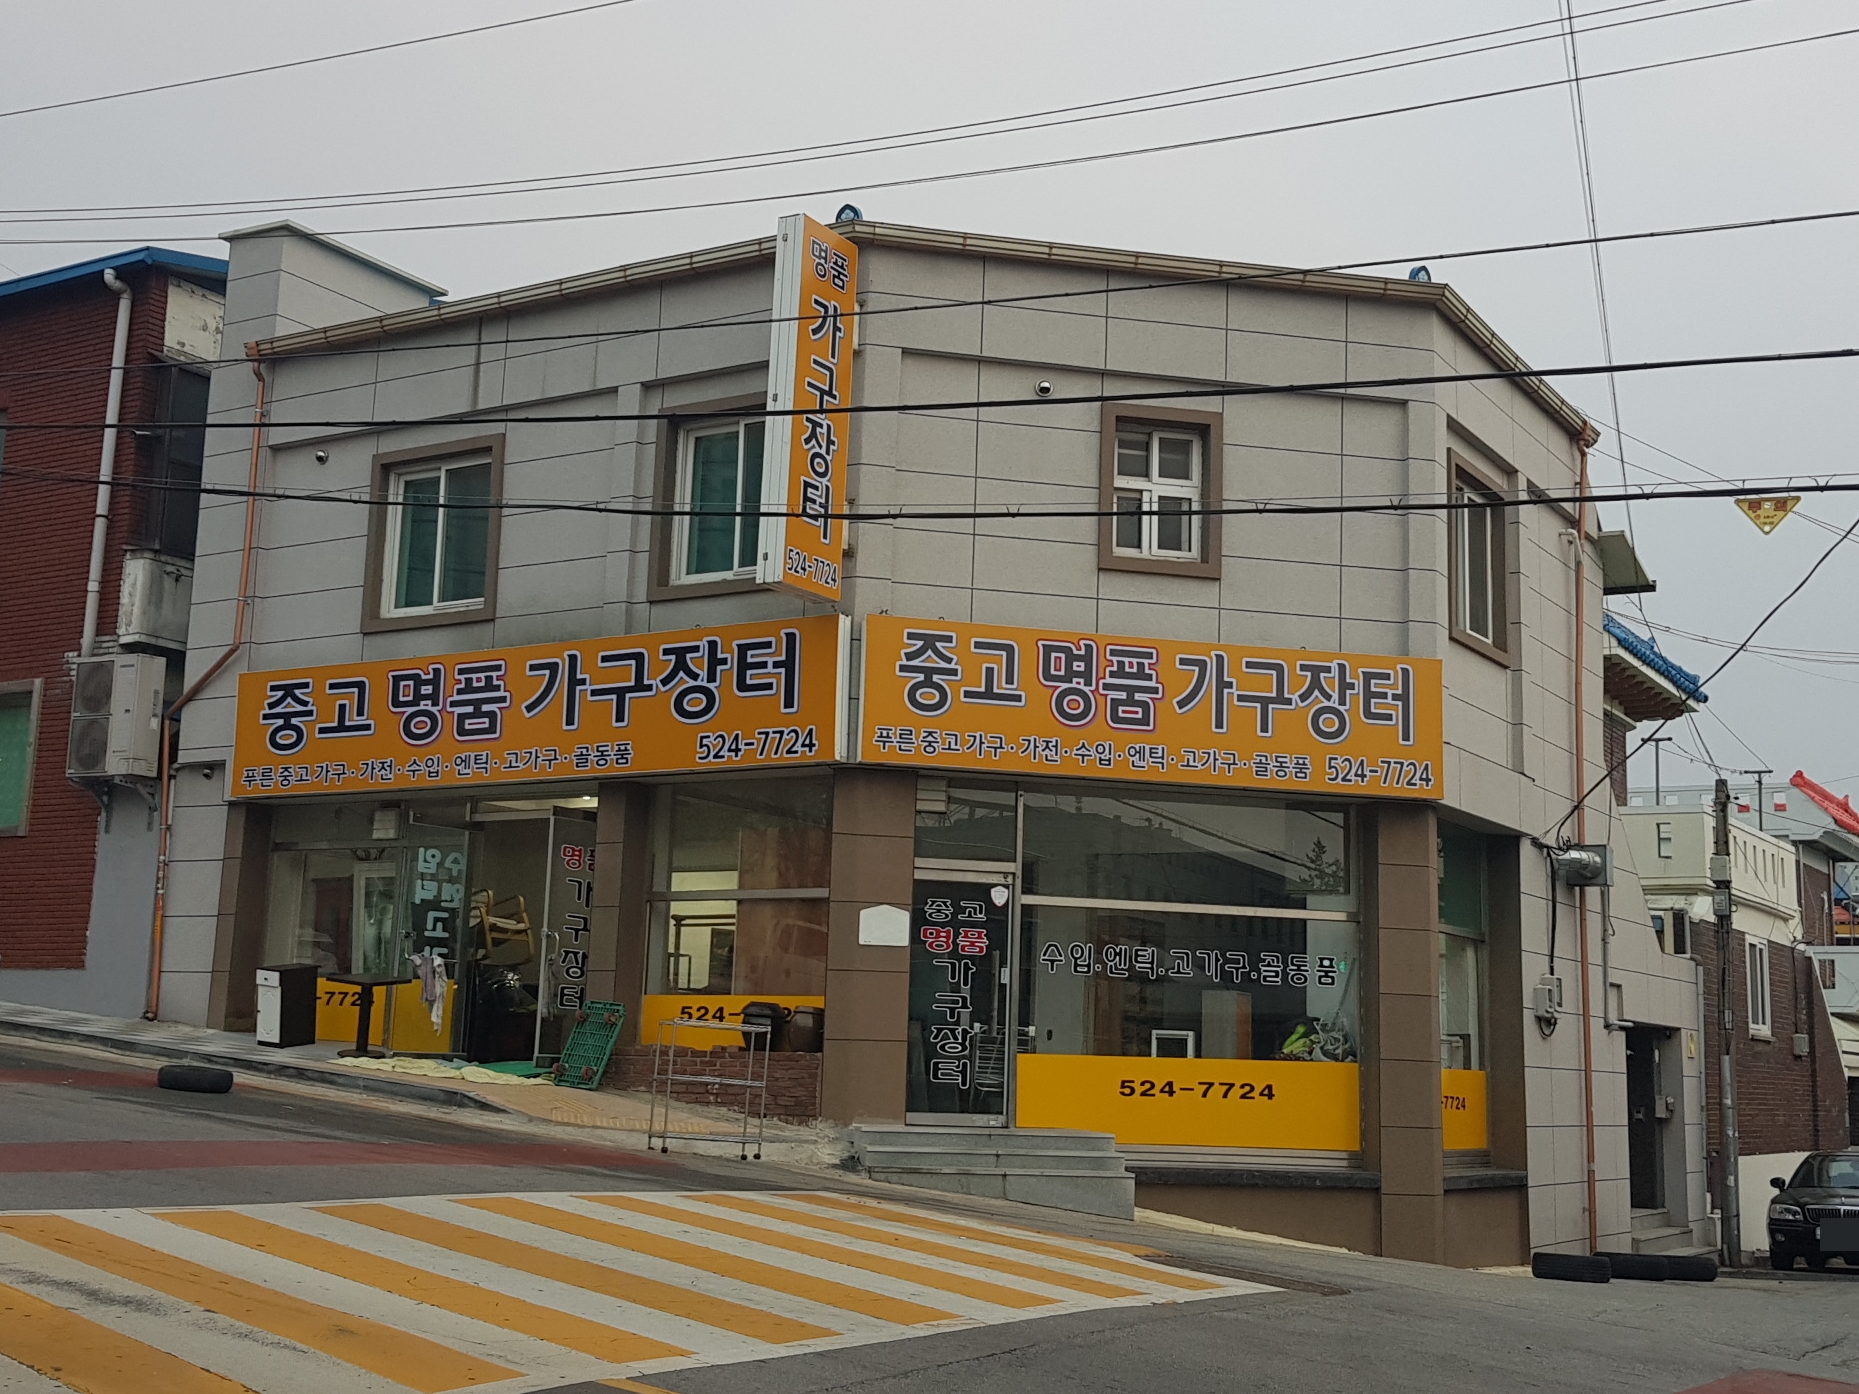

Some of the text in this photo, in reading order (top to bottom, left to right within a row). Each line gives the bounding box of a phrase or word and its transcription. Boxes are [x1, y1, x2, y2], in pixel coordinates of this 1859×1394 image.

[809, 235, 850, 293] 명품
[800, 295, 846, 545] 가구장터
[785, 546, 839, 590] 524-7724
[259, 627, 803, 756] 중고 명품 가구장터
[895, 628, 1415, 746] 중고 명품 가구장터
[696, 725, 818, 763] 524-7724
[1325, 755, 1434, 790] 524-7724
[924, 898, 987, 922] 중고
[920, 926, 989, 956] 명품
[930, 958, 976, 1089] 가구장터
[1119, 1078, 1277, 1101] 524-7724
